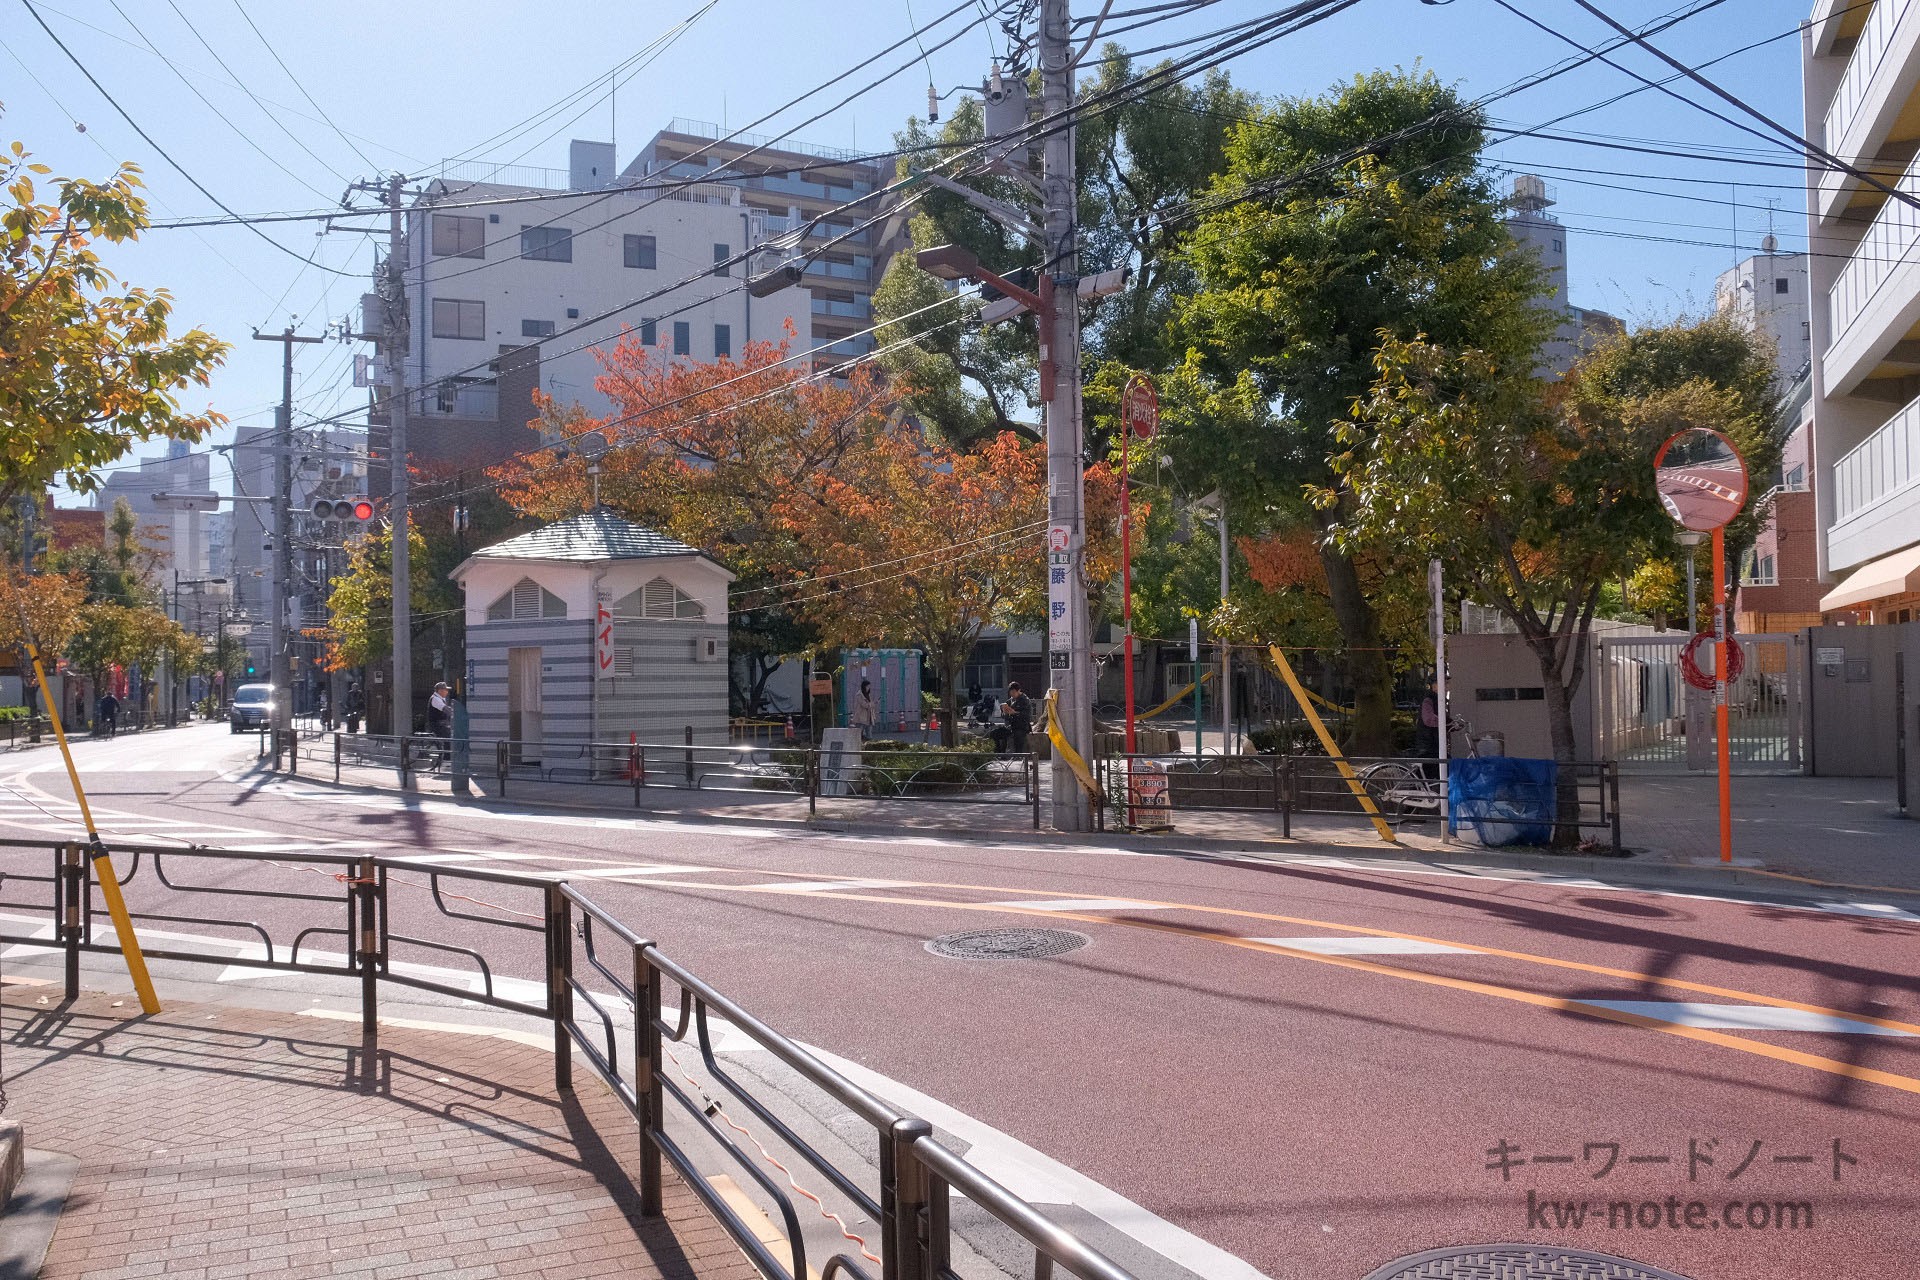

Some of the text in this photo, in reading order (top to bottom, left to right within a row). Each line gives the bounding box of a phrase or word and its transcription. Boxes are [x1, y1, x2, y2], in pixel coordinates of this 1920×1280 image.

[1051, 529, 1067, 550] 質
[1052, 567, 1067, 620] 藤野
[598, 602, 612, 670] トイレ
